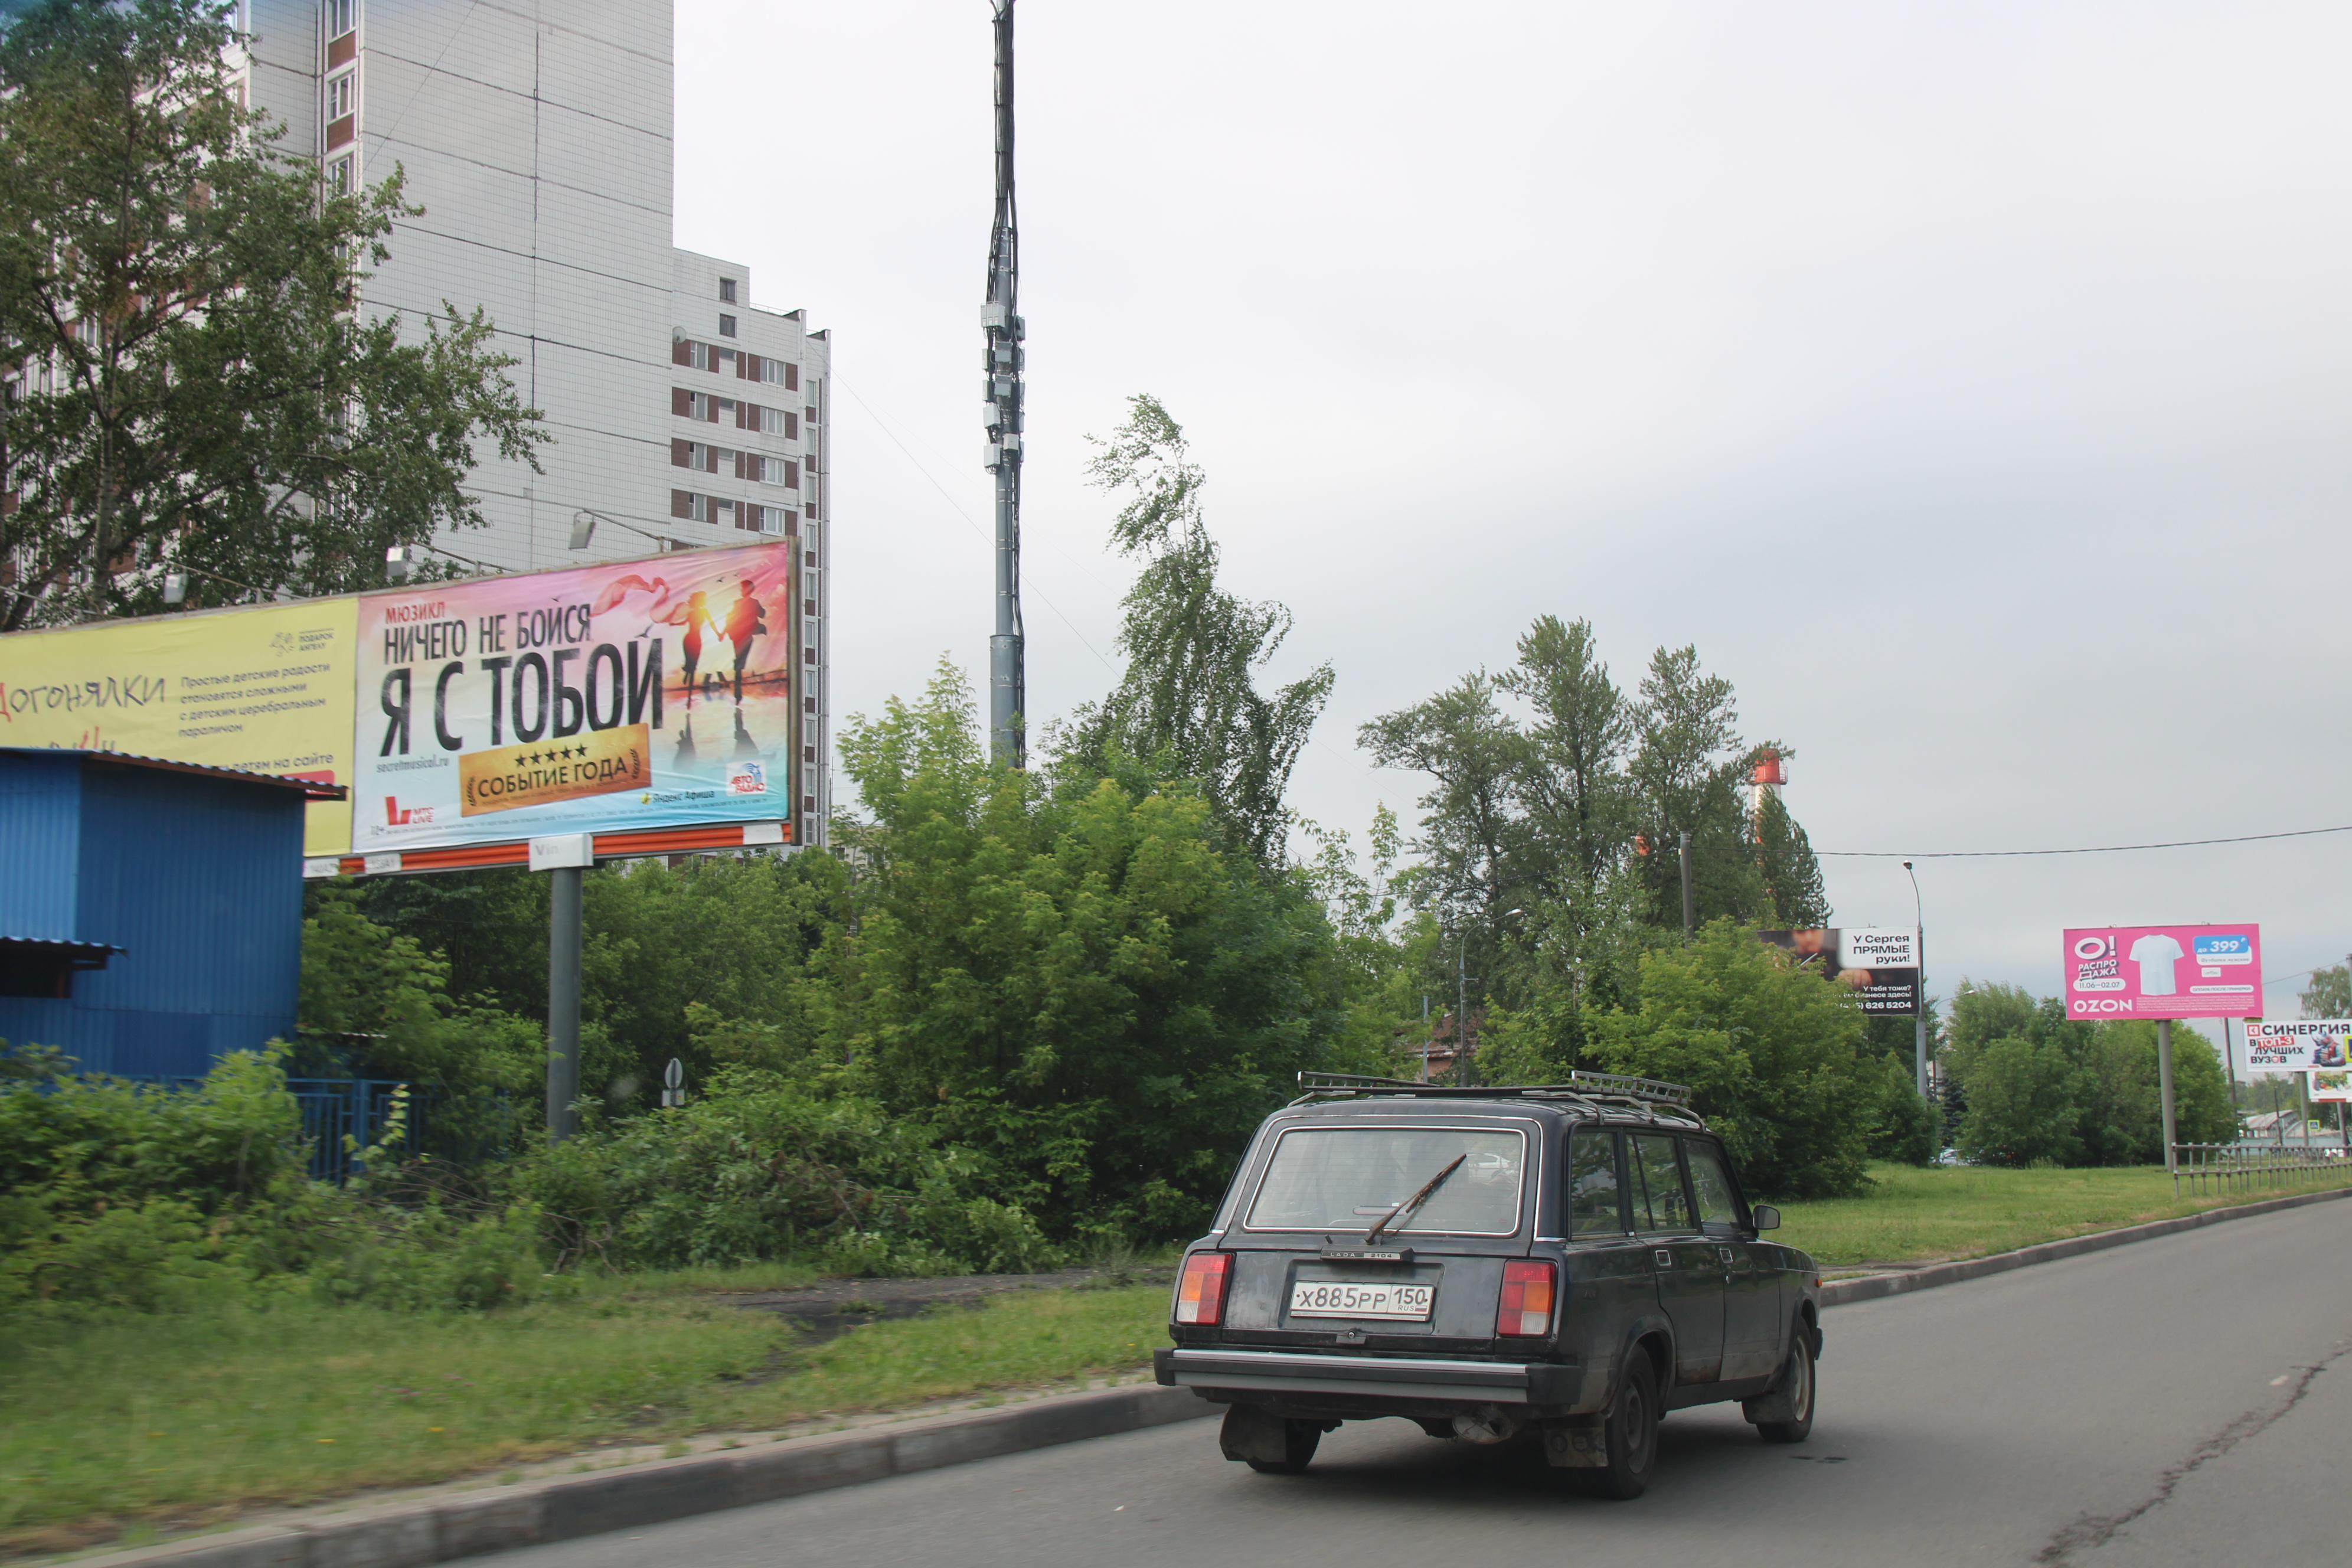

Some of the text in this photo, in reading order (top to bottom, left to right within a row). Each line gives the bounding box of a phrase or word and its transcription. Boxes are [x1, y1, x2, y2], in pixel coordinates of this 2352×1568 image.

[386, 602, 446, 624] МЮЗИКЛ
[384, 619, 467, 665] НИЧЕГО
[479, 614, 507, 654] НЕ
[181, 663, 330, 689] Простые детские радости
[180, 682, 306, 704] становятся сложными
[189, 708, 236, 721] детским
[239, 698, 326, 716] церебральным
[380, 668, 411, 757] Я
[434, 661, 464, 751] С
[179, 723, 243, 738] параличом
[274, 758, 289, 769] на
[293, 752, 334, 767] сайте
[478, 766, 569, 798] СОБЫТИЕ
[574, 756, 628, 781] ГОДА
[1864, 935, 1910, 945] Сергея
[2210, 940, 2239, 952] 399
[1853, 945, 1910, 954] ПРЯМЫЕ
[1876, 954, 1910, 965] руки!
[2078, 959, 2117, 971] РАСПРО
[2078, 968, 2117, 981] ДАЖА
[2073, 999, 2132, 1013] OZON
[2262, 1024, 2350, 1035] СИНЕРГИЯ
[2255, 1047, 2304, 1055] ЛУЧШИХ
[1393, 1288, 1426, 1305] 150
